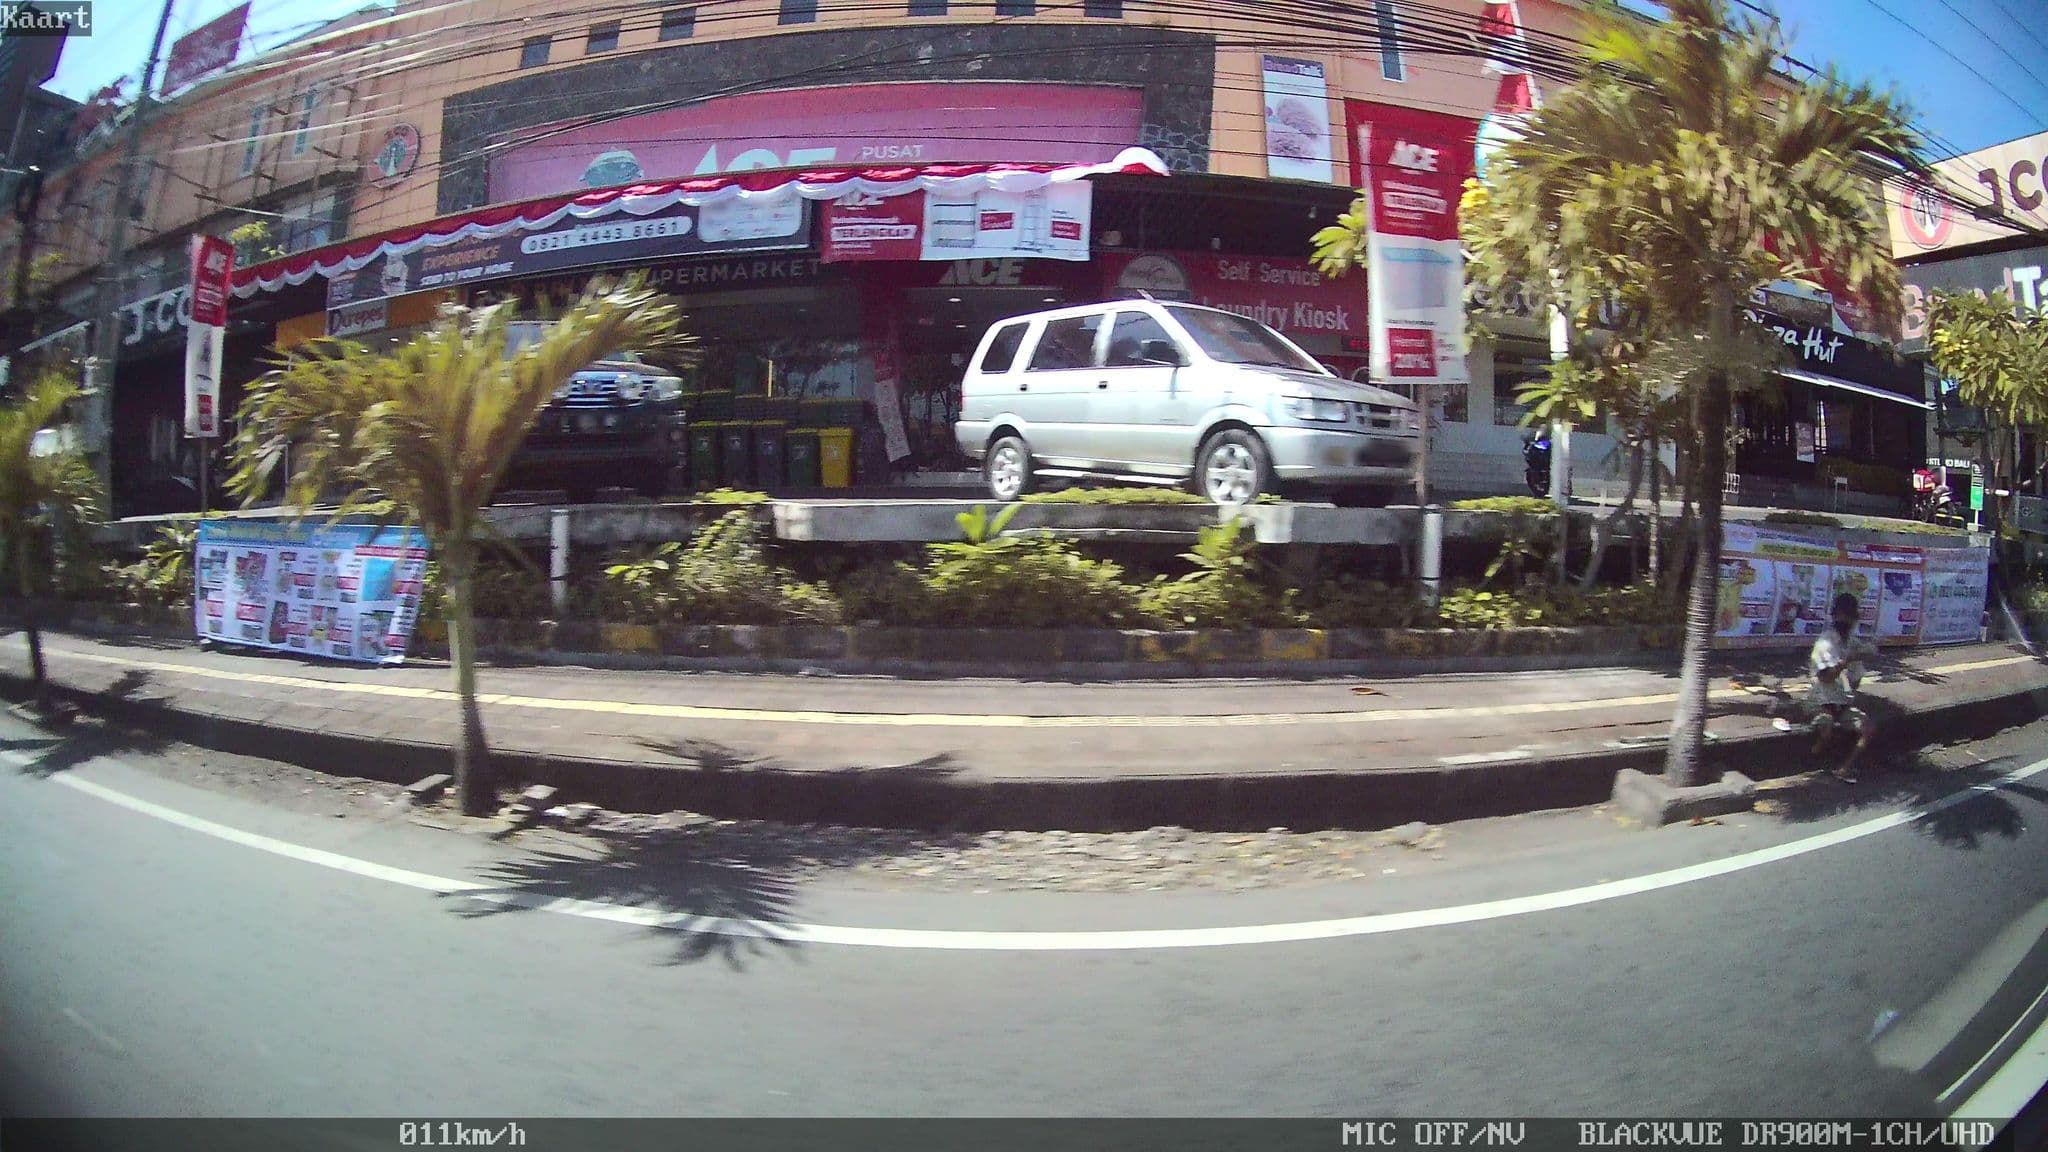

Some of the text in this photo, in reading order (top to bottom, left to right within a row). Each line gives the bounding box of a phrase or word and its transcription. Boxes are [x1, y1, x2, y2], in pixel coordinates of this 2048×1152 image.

[862, 144, 924, 160] PUSAT
[1388, 138, 1440, 172] ACE
[578, 228, 623, 244] 4443
[938, 258, 1025, 286] ACE
[1218, 260, 1321, 287] Self Service
[1294, 302, 1350, 331] Kiosk
[1803, 326, 1844, 363] Hut
